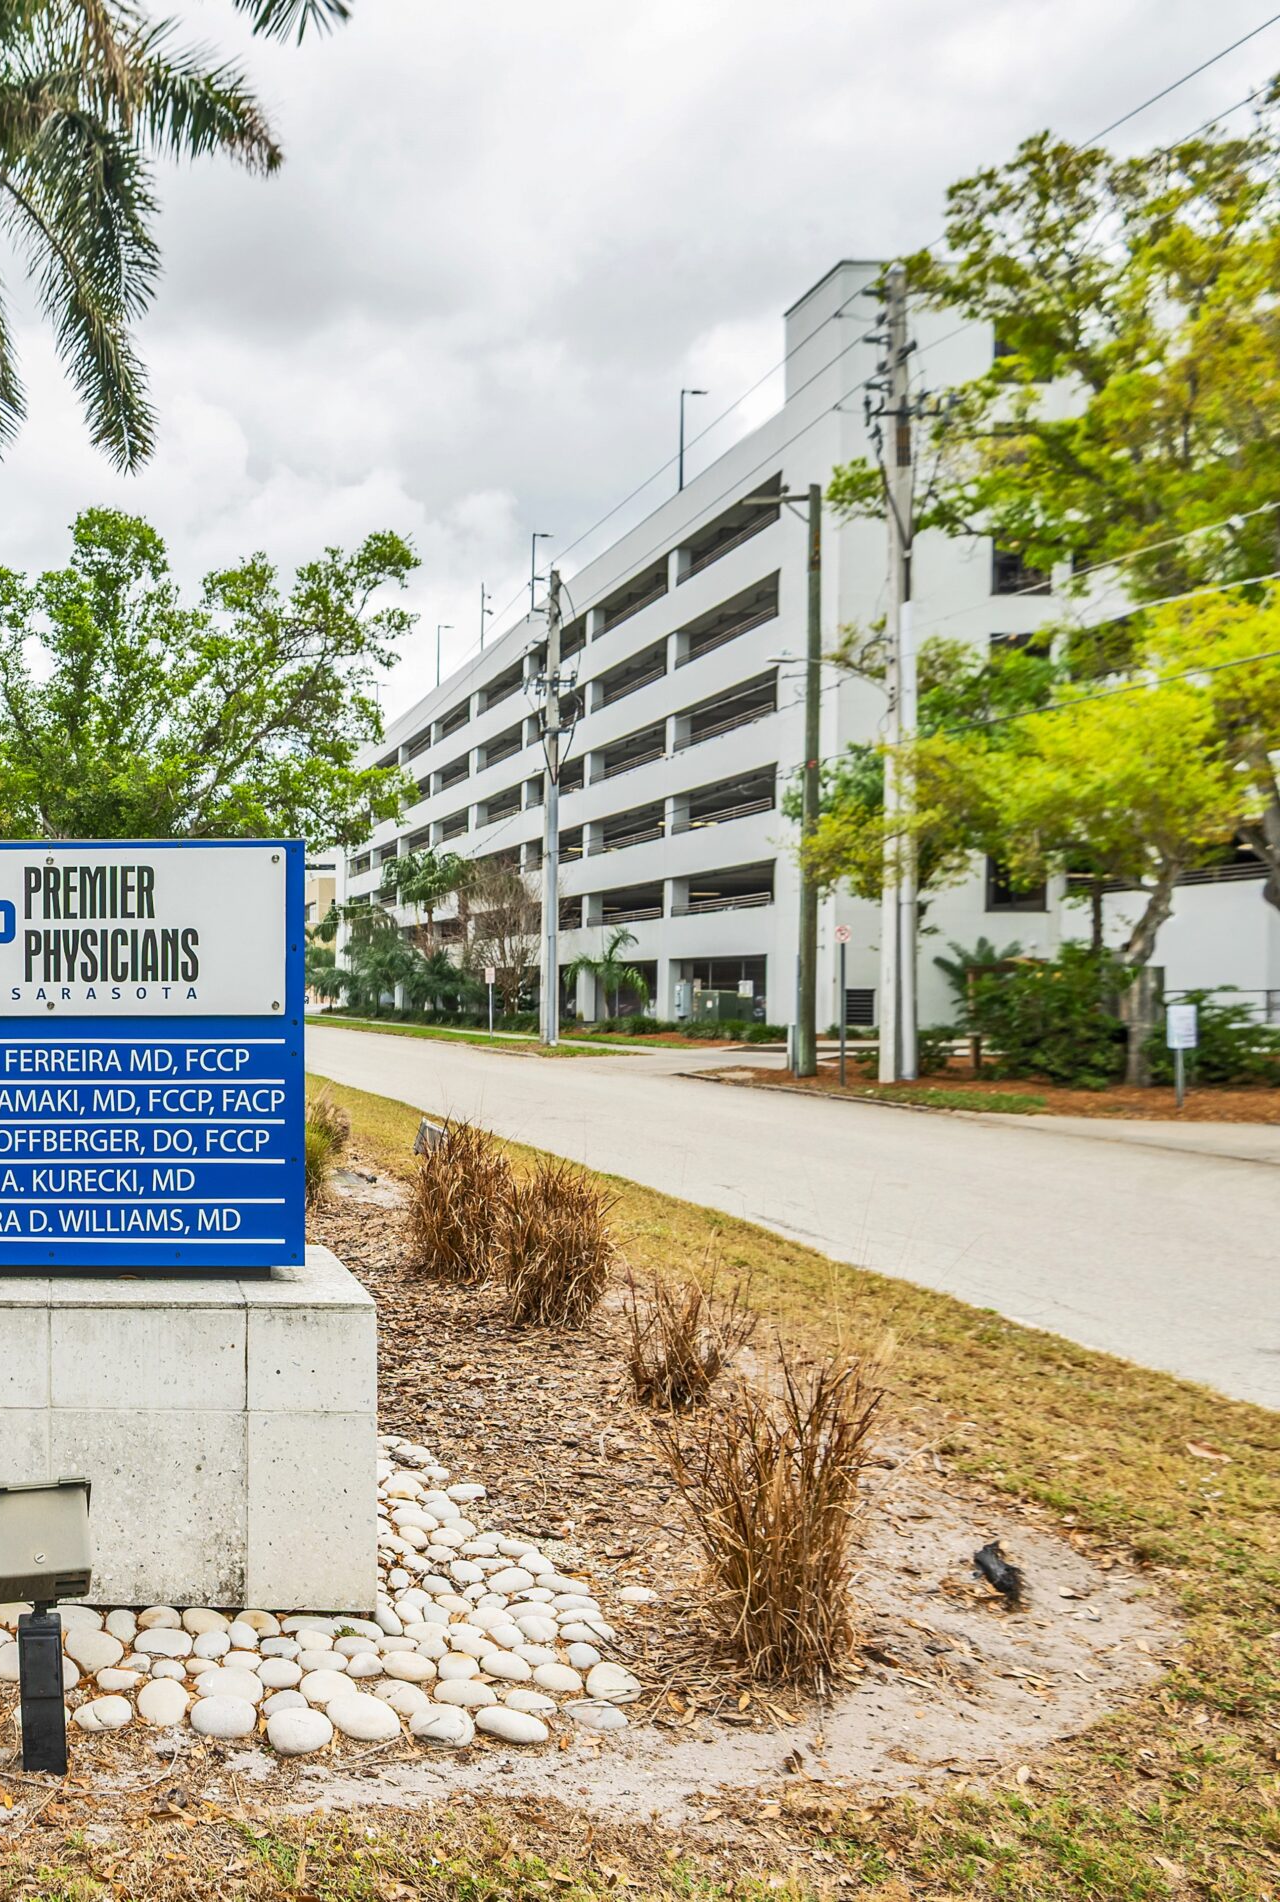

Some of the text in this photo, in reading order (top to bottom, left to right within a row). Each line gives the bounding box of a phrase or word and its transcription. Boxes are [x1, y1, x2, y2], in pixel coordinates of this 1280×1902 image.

[24, 866, 156, 920] PREMIER
[24, 927, 199, 983] PHYSICIANS
[11, 986, 198, 1001] SARASOTA
[5, 1049, 122, 1072] FERREIRA
[129, 1049, 178, 1075] MD,
[186, 1048, 250, 1072] FCCP
[92, 1089, 141, 1116] MD,
[149, 1089, 215, 1116] FCCP,
[222, 1089, 286, 1113] FACP
[153, 1128, 198, 1156] DO,
[206, 1129, 270, 1153] FCCP
[0, 1169, 25, 1192] A.
[32, 1168, 145, 1195] KURECKI,
[152, 1168, 196, 1192] MD
[29, 1209, 53, 1233] D.
[58, 1208, 190, 1235] WILLIAMS,
[197, 1208, 241, 1232] MD
